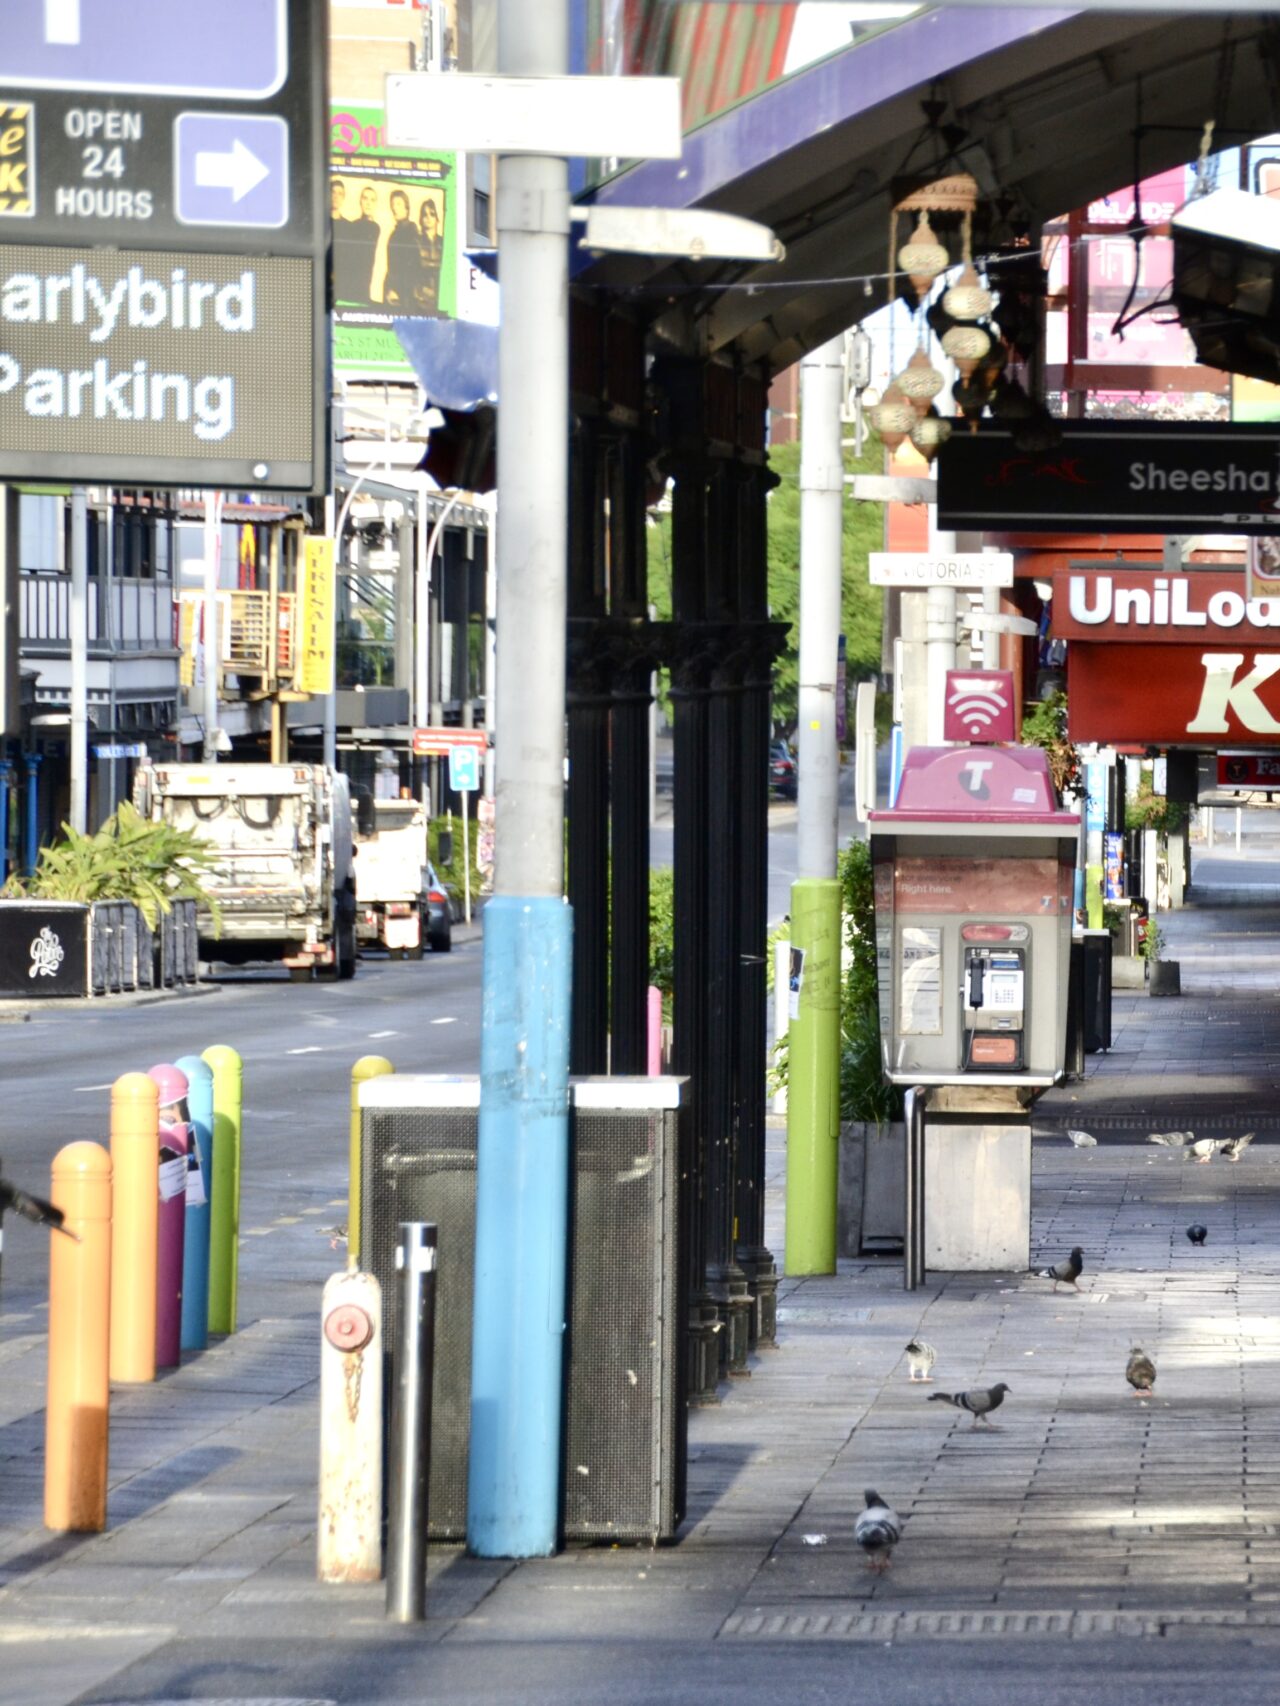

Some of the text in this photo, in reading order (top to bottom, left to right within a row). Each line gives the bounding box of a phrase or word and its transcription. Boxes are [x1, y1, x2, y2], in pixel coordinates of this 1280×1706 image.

[64, 109, 142, 140] OPEN
[82, 146, 125, 178] 24
[55, 187, 153, 219] HOURS
[1129, 462, 1270, 492] Sheesha
[454, 749, 472, 772] P
[901, 883, 927, 895] Right
